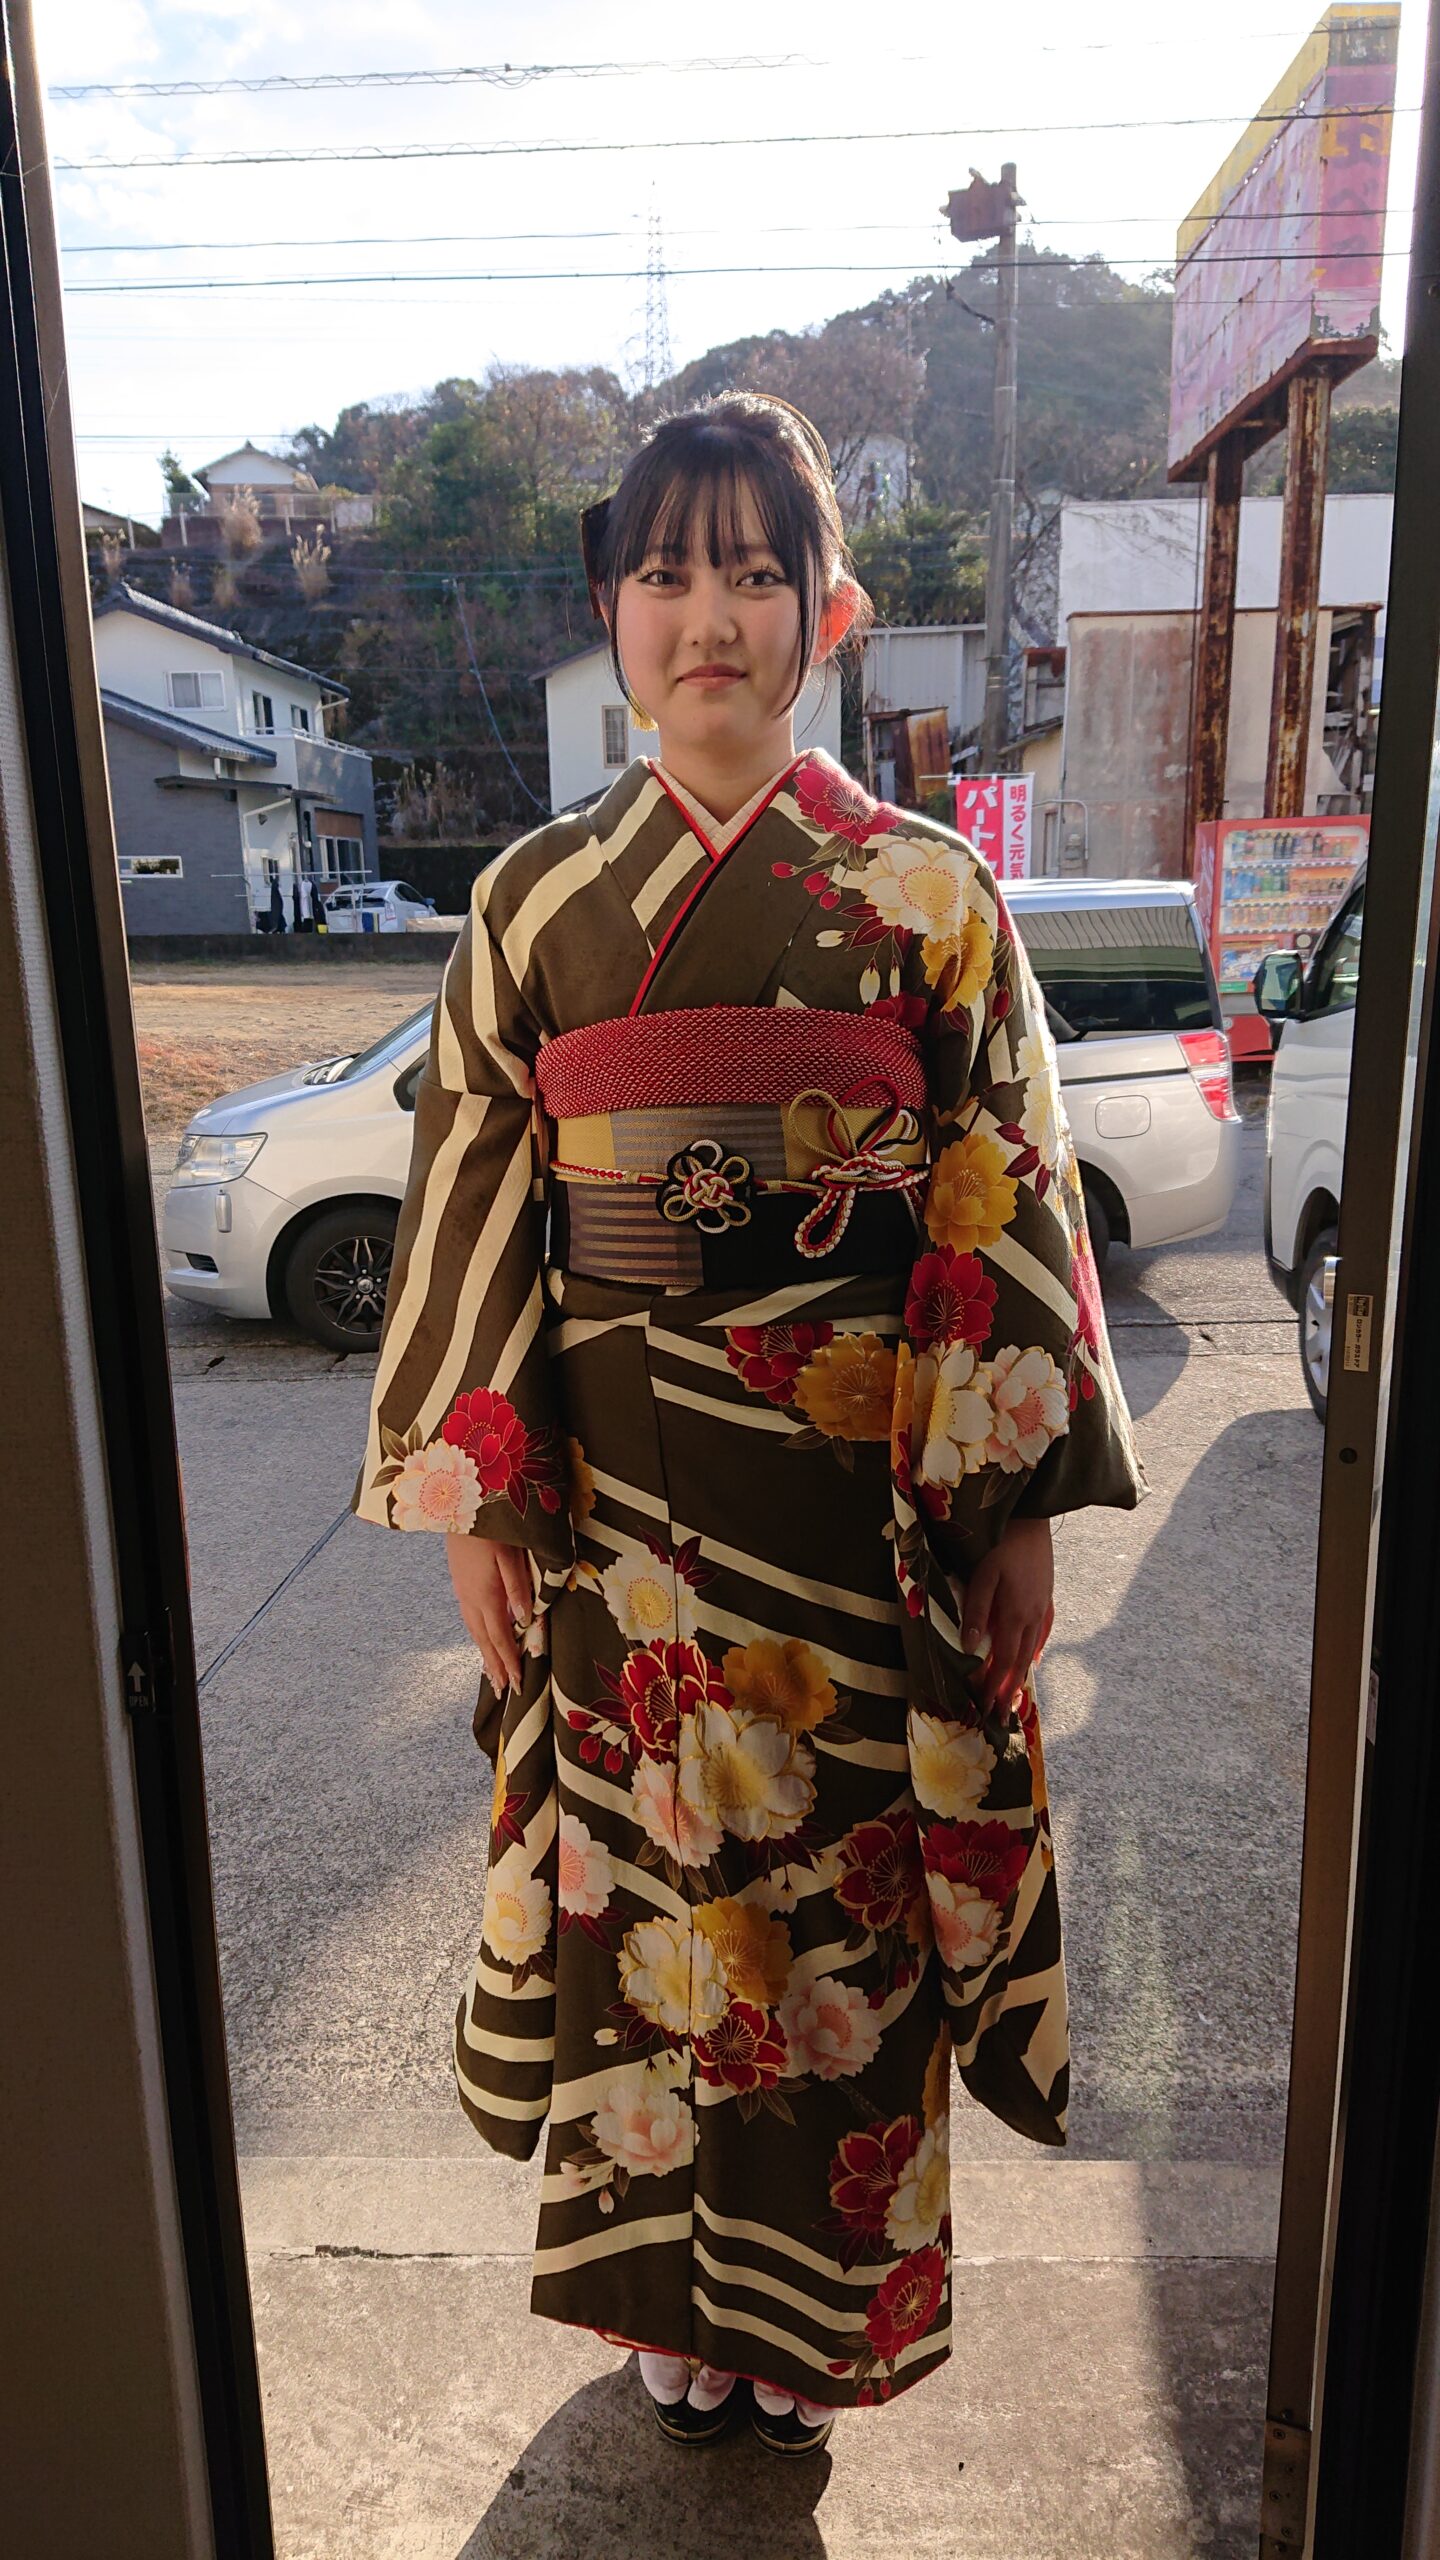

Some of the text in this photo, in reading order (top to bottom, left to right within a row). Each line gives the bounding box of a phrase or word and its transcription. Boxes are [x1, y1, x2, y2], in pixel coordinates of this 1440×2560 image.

[1010, 784, 1026, 880] 明るく元気
